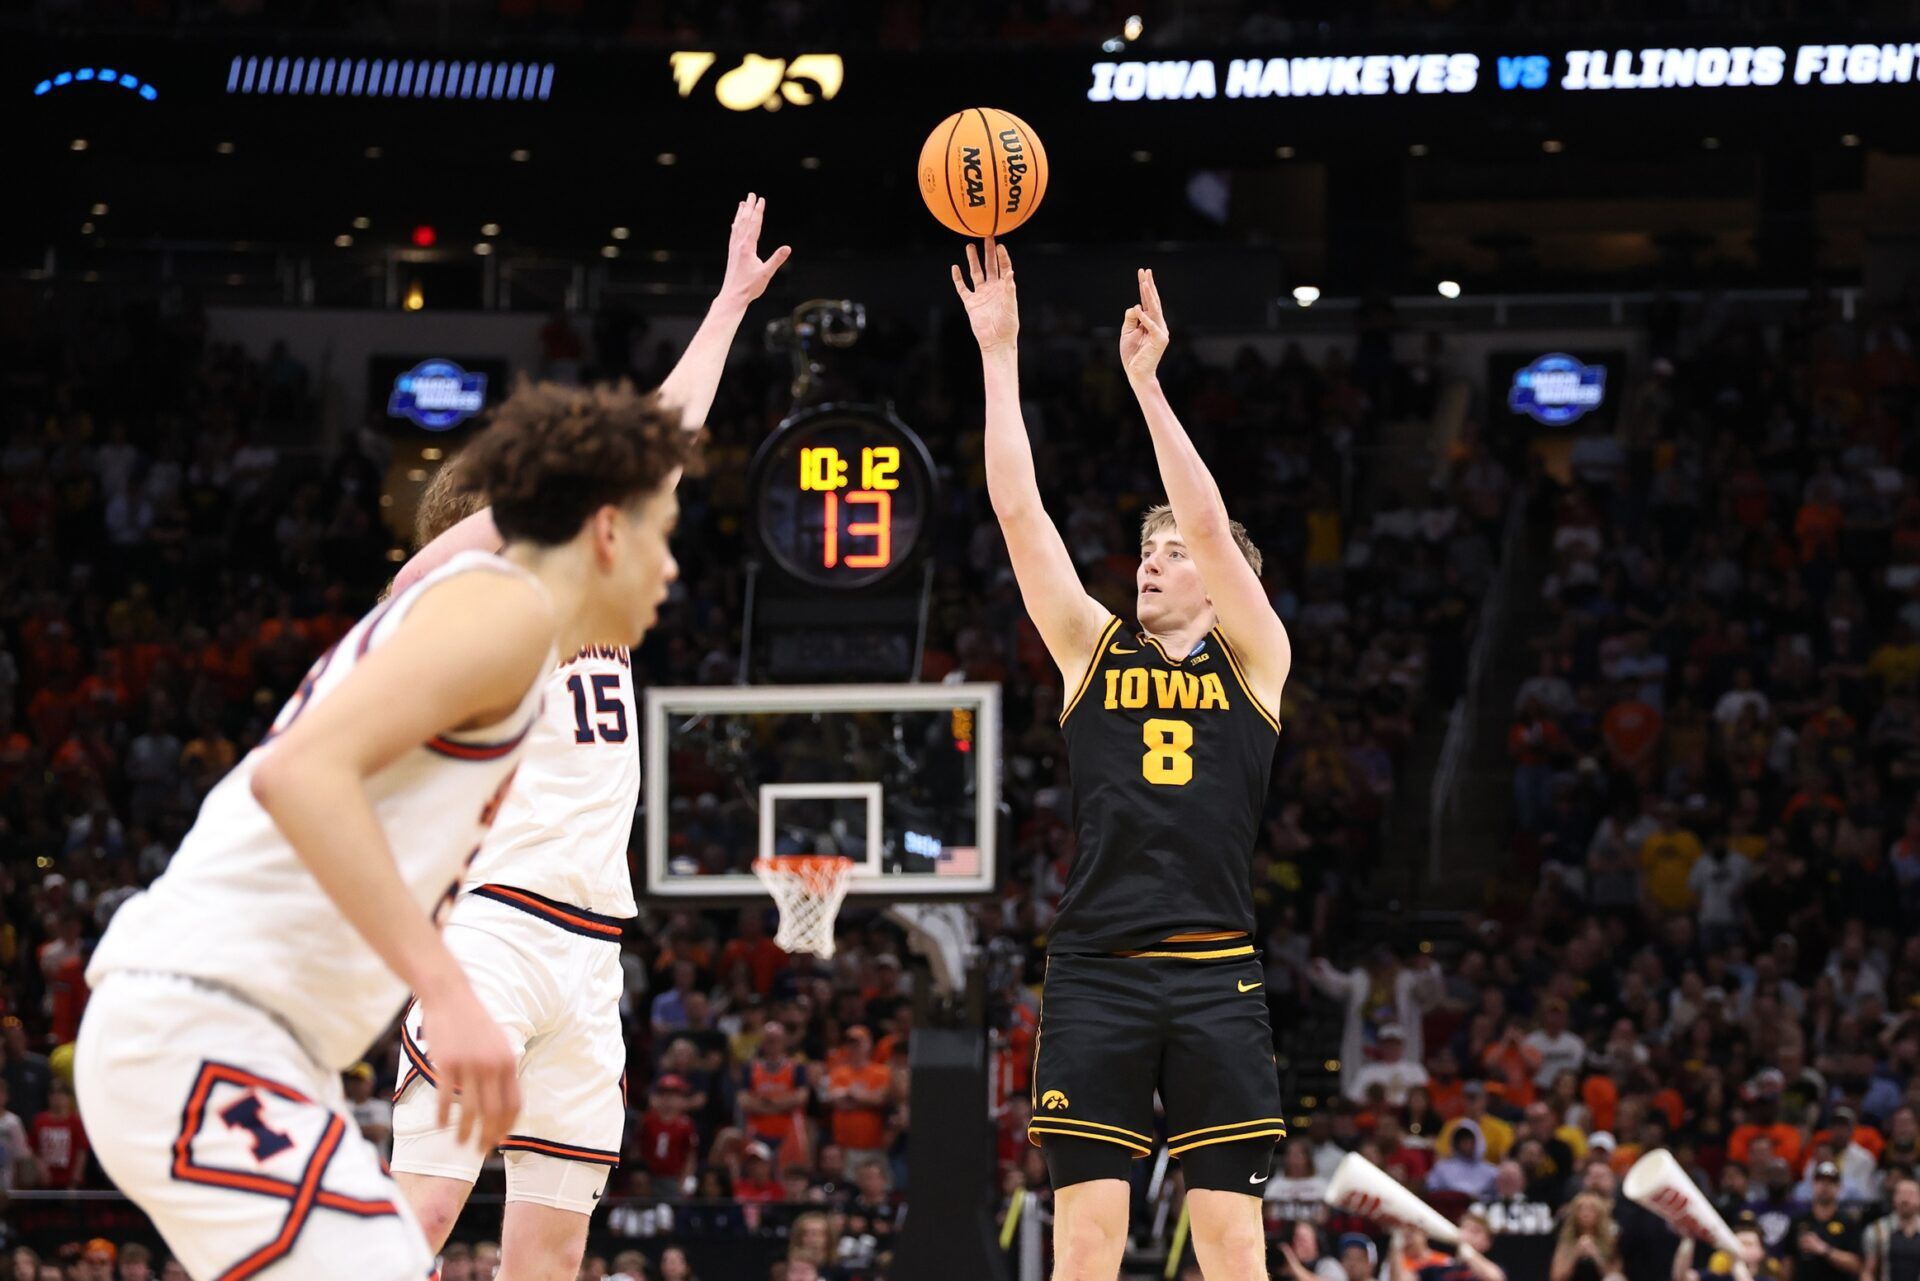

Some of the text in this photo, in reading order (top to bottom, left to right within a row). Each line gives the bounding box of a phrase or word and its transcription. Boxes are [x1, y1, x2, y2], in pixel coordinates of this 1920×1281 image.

[1087, 60, 1216, 101] IOWA
[1225, 53, 1480, 98] HAWKEYES
[1497, 55, 1550, 89] VS
[1561, 46, 1786, 90] ILLINOIS
[963, 147, 985, 207] NCAA
[999, 129, 1028, 214] Wilson
[824, 490, 891, 568] 13
[566, 673, 628, 744] 15
[1104, 667, 1229, 711] IOWA
[1142, 718, 1193, 786] 8
